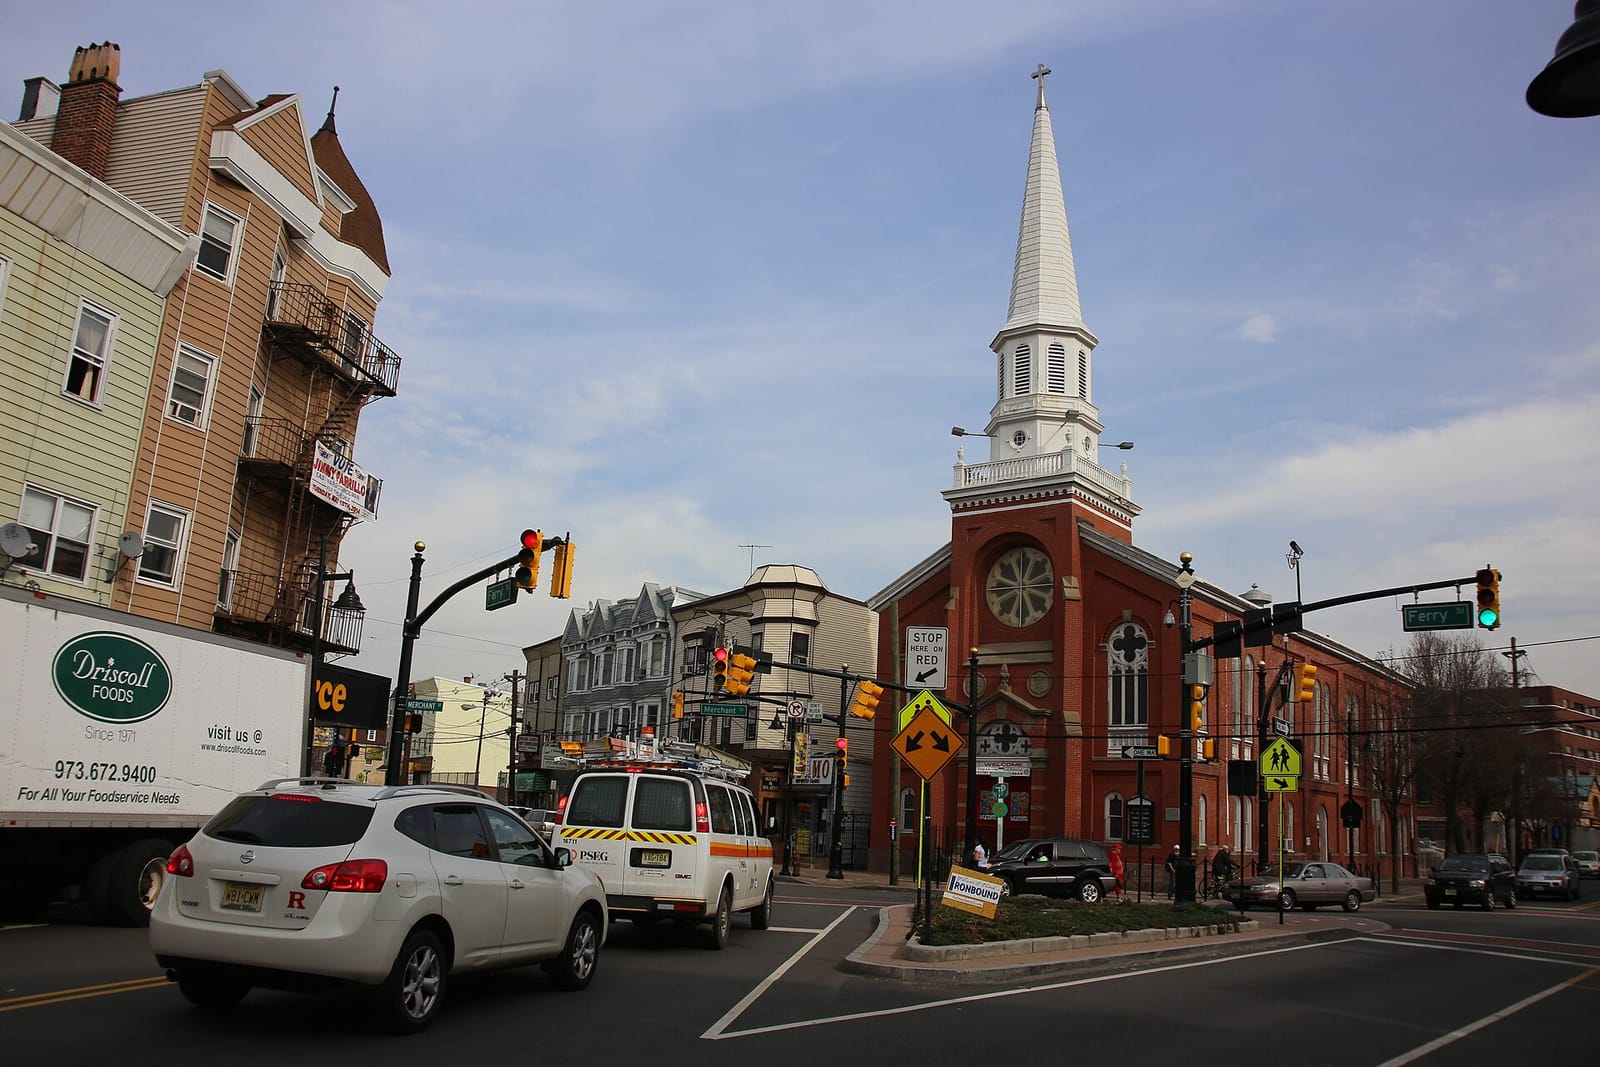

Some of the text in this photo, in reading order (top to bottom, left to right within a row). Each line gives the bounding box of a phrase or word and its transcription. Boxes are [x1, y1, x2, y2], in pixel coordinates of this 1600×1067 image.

[1408, 610, 1448, 623] Ferry
[913, 633, 943, 642] STOP
[72, 649, 157, 688] Driscoll
[916, 655, 938, 665] RED
[92, 685, 134, 703] FOODS
[407, 701, 436, 710] MERCHANT
[703, 705, 736, 714] Merchant
[85, 725, 136, 744] Since 1971
[208, 724, 263, 743] visit us @
[201, 743, 267, 757] www.driscollfoods.com
[54, 760, 156, 783] 973.672.9400
[17, 787, 180, 804] For All Your Foodservice Needs
[580, 850, 608, 861] PSEG
[949, 875, 998, 900] IRONBOUND
[287, 891, 305, 909] R
